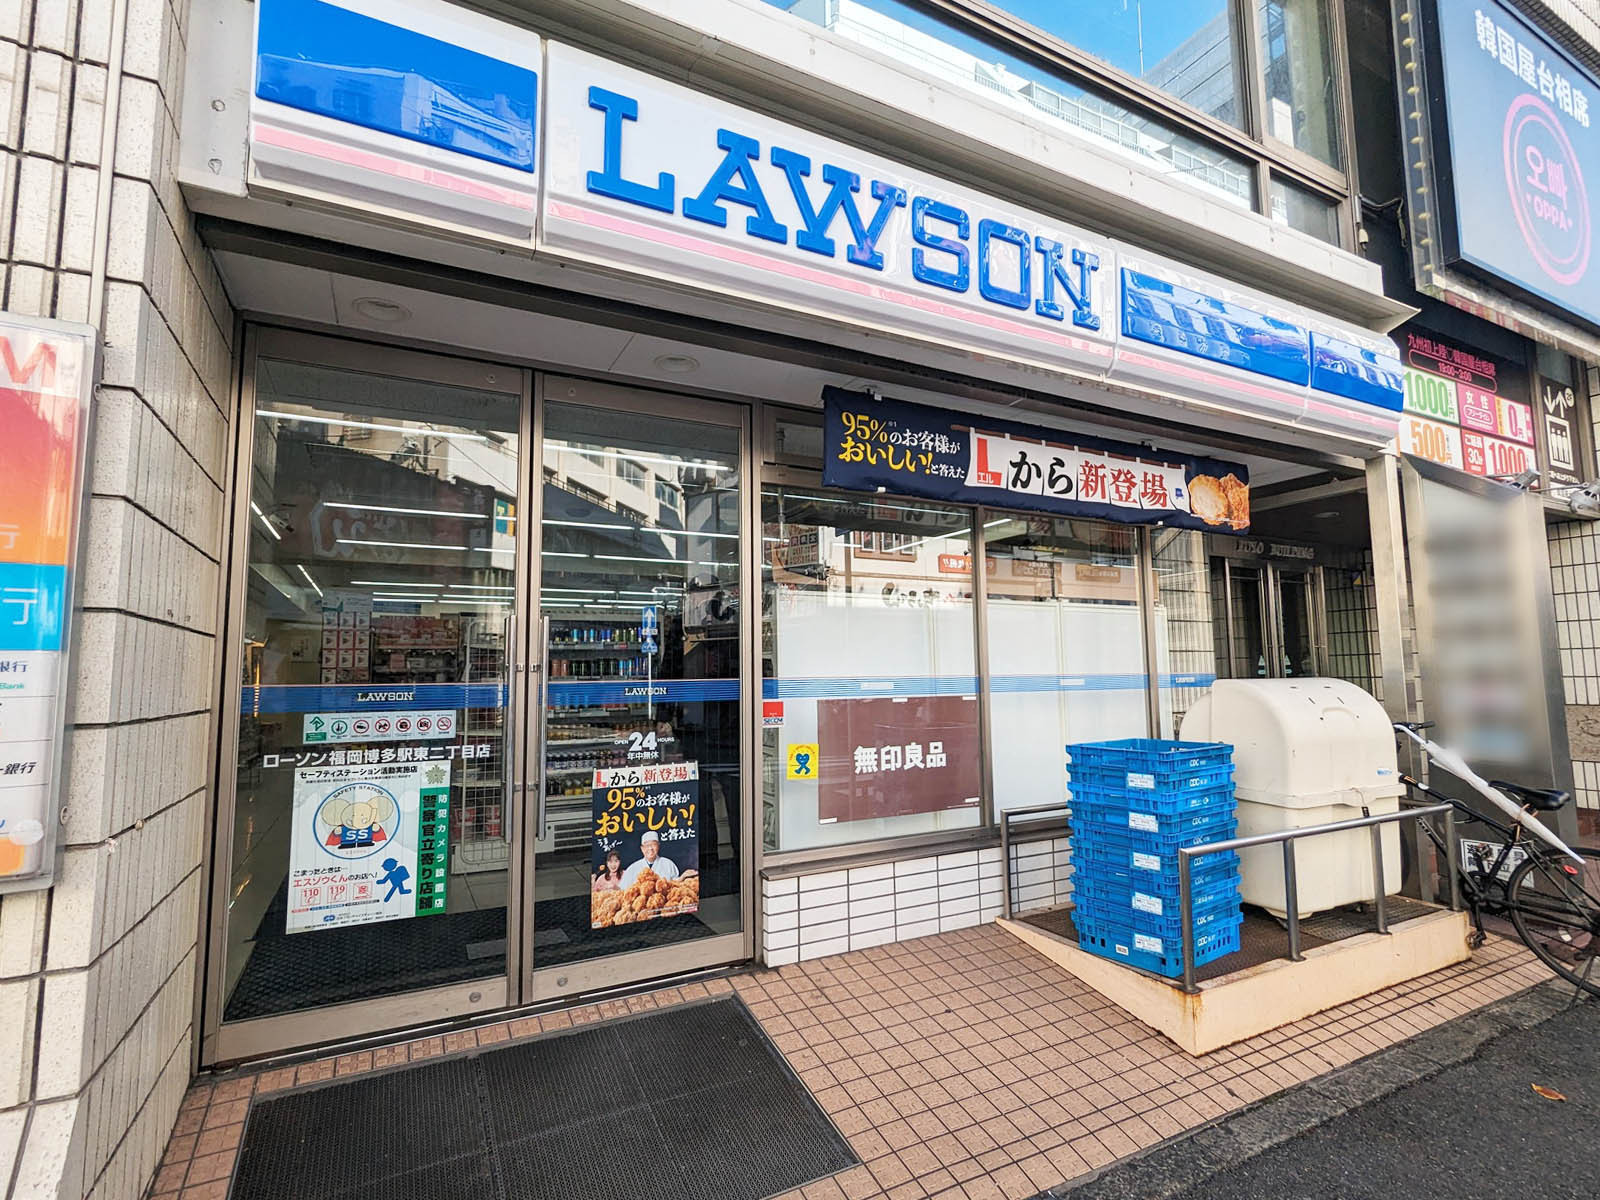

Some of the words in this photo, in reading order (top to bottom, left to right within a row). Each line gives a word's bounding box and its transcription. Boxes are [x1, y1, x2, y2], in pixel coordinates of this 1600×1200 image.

[1474, 9, 1591, 128] 韓国屋台相席
[586, 85, 1101, 331] LAWSON
[1533, 196, 1568, 232] OPPA
[1465, 390, 1488, 410] 女性
[930, 463, 966, 479] と答えた
[978, 472, 995, 484] エル
[1271, 543, 1315, 559] BUILDING
[357, 692, 414, 701] LAWSON
[624, 687, 667, 696] LAWSON
[629, 731, 658, 752] 24
[657, 735, 675, 743] HOURS
[263, 744, 491, 768] ローソン福岡博多駅東二丁目店
[627, 751, 659, 761] 年中無休
[853, 741, 947, 775] 無印良品
[333, 786, 357, 799] SAFETY
[358, 785, 384, 796] STATION
[594, 803, 697, 837] おいしい!
[346, 829, 369, 841] SS
[660, 827, 697, 842] と答えた
[303, 888, 319, 897] 110
[330, 885, 345, 894] 119
